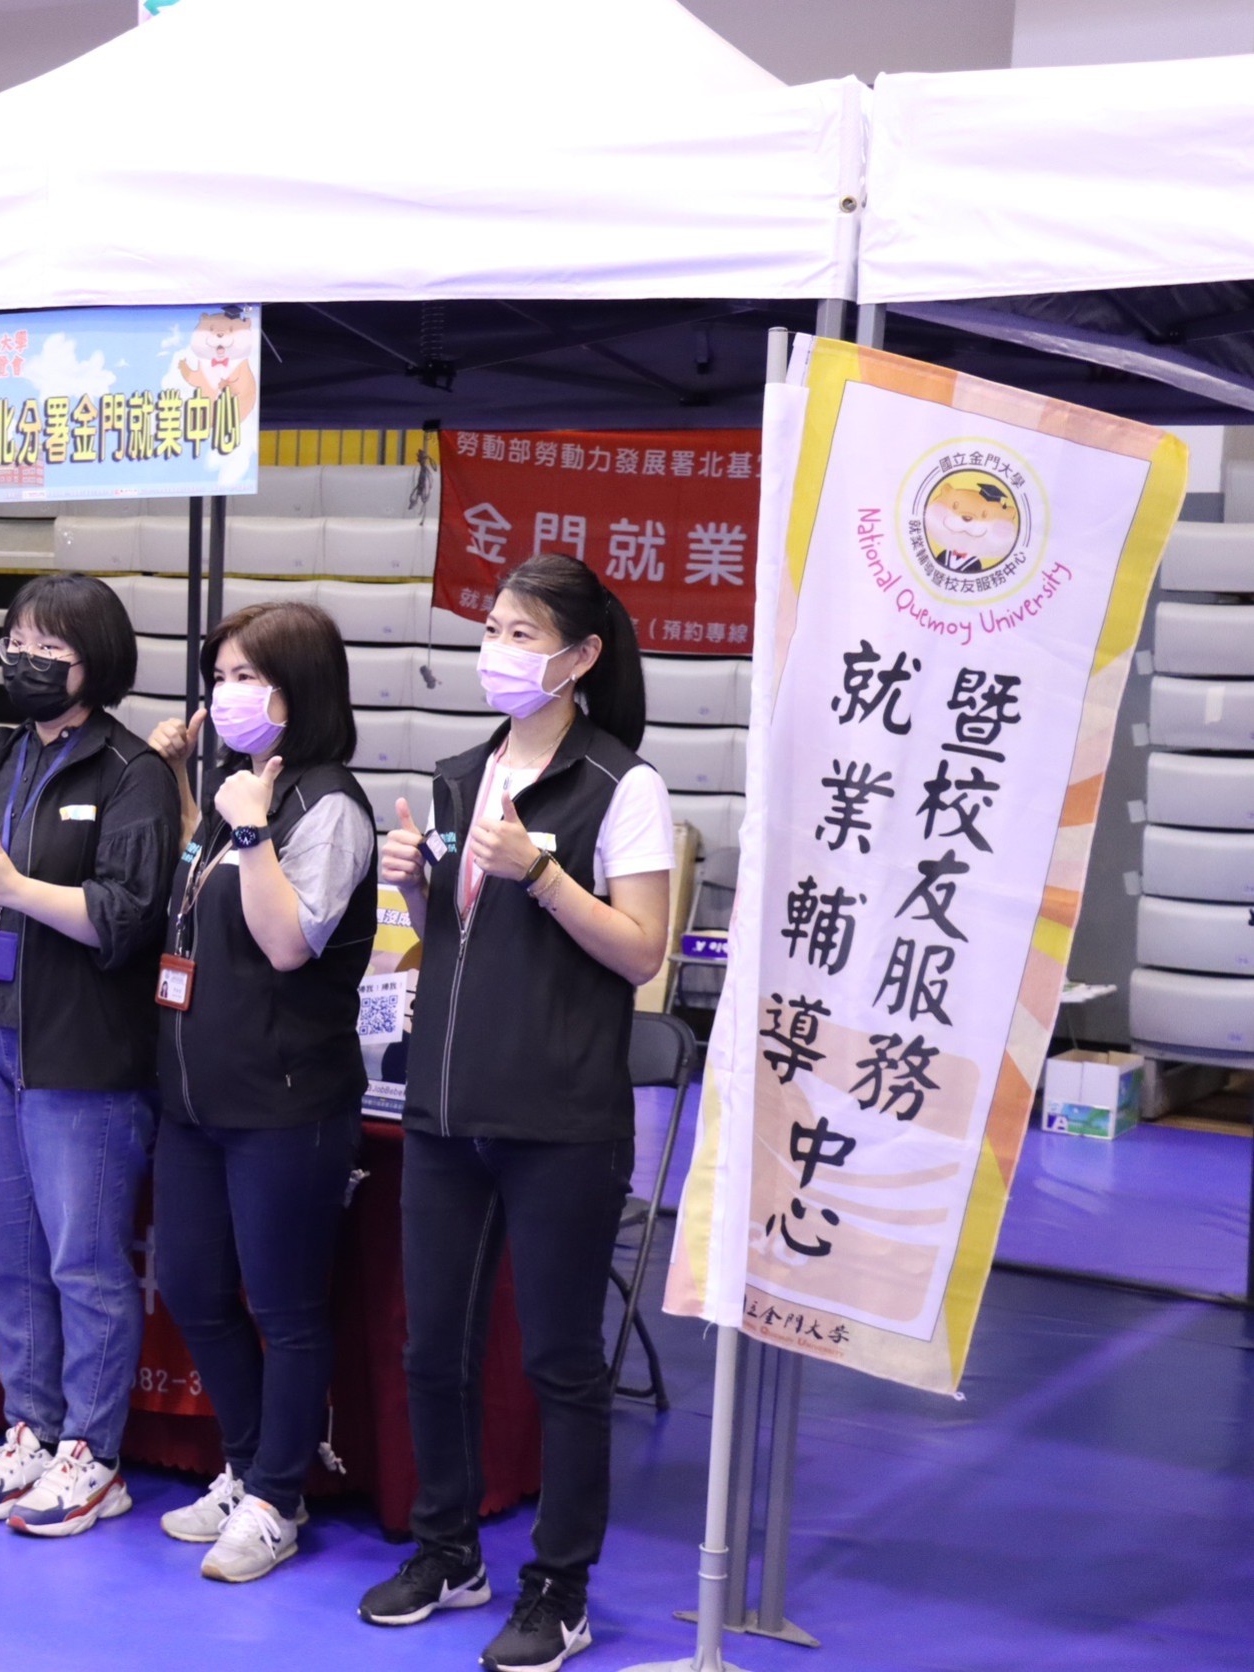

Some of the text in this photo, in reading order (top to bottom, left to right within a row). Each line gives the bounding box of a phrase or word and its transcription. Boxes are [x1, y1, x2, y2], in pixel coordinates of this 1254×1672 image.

[456, 431, 762, 480] 勞動部勞動力發展署北基
[939, 451, 1026, 489] 國立金門大學
[857, 507, 1073, 646] National Quemoy University
[758, 640, 922, 1258] 就業輔導中心
[849, 668, 1024, 1122] 暨校友服務
